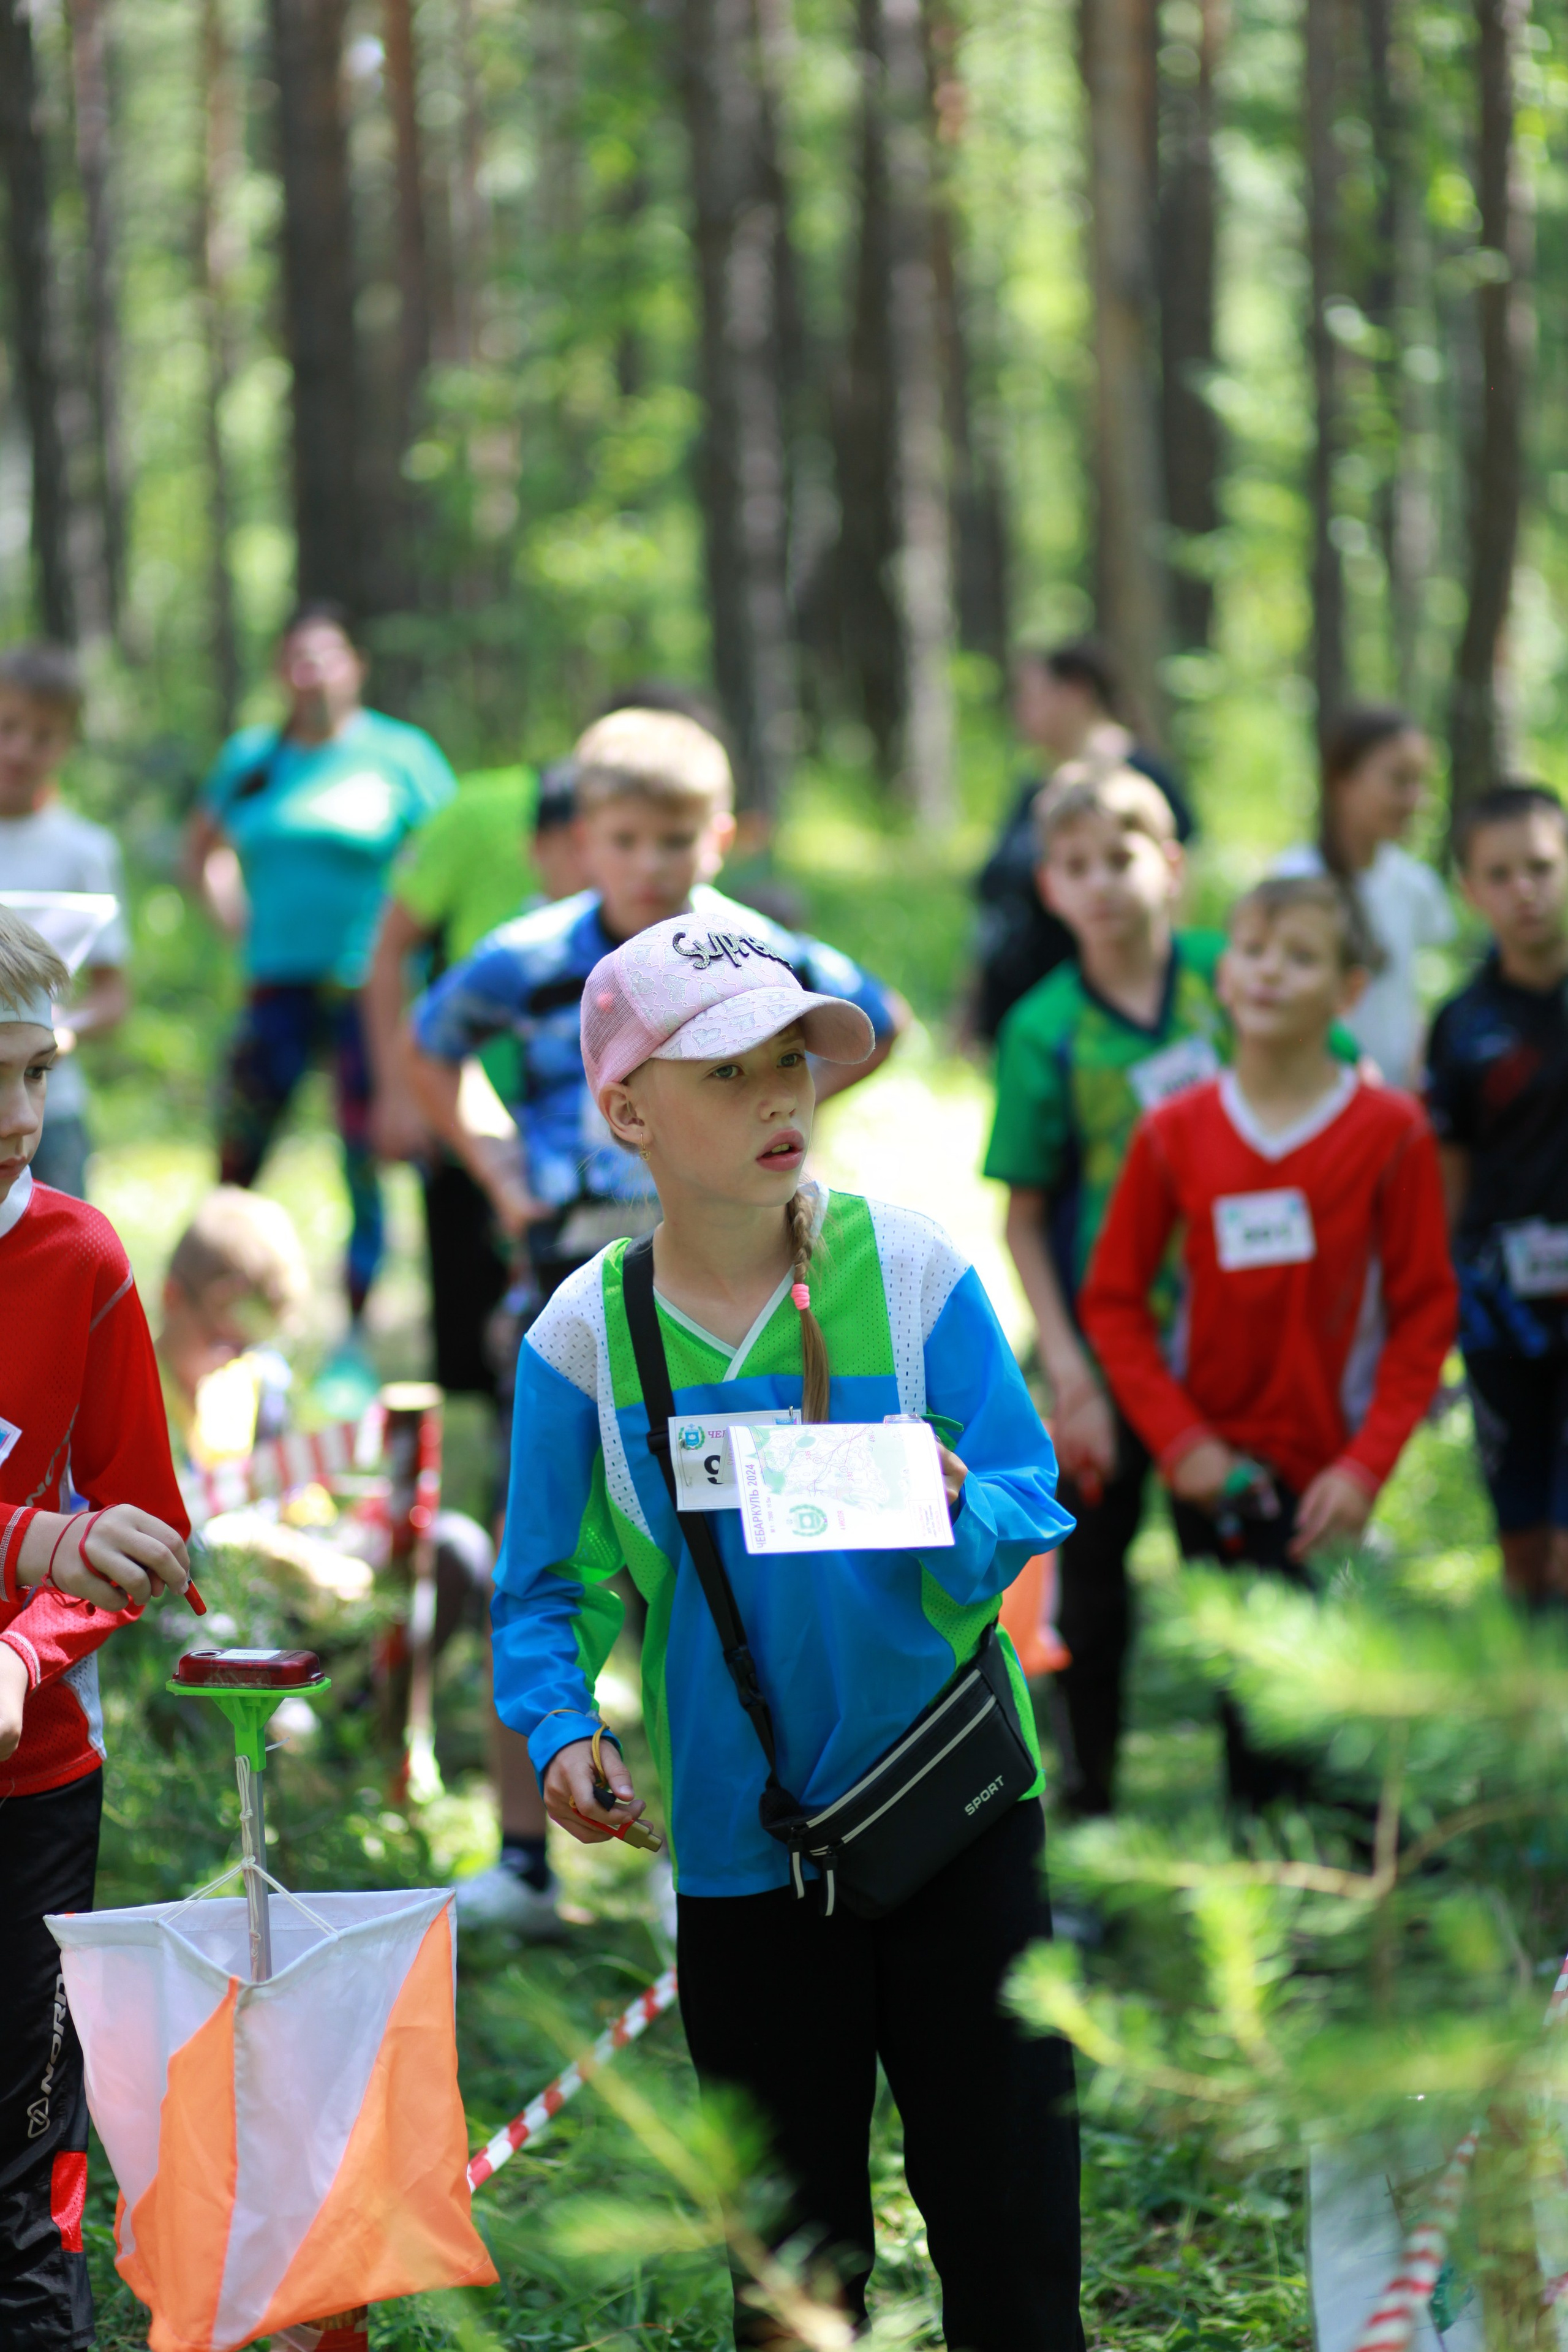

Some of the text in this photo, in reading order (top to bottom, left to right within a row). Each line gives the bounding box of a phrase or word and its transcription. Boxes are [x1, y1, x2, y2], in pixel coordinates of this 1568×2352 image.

[745, 1463, 766, 1548] ЧЕБАРКУЛЬ 2024
[964, 1775, 1004, 1815] SPORT
